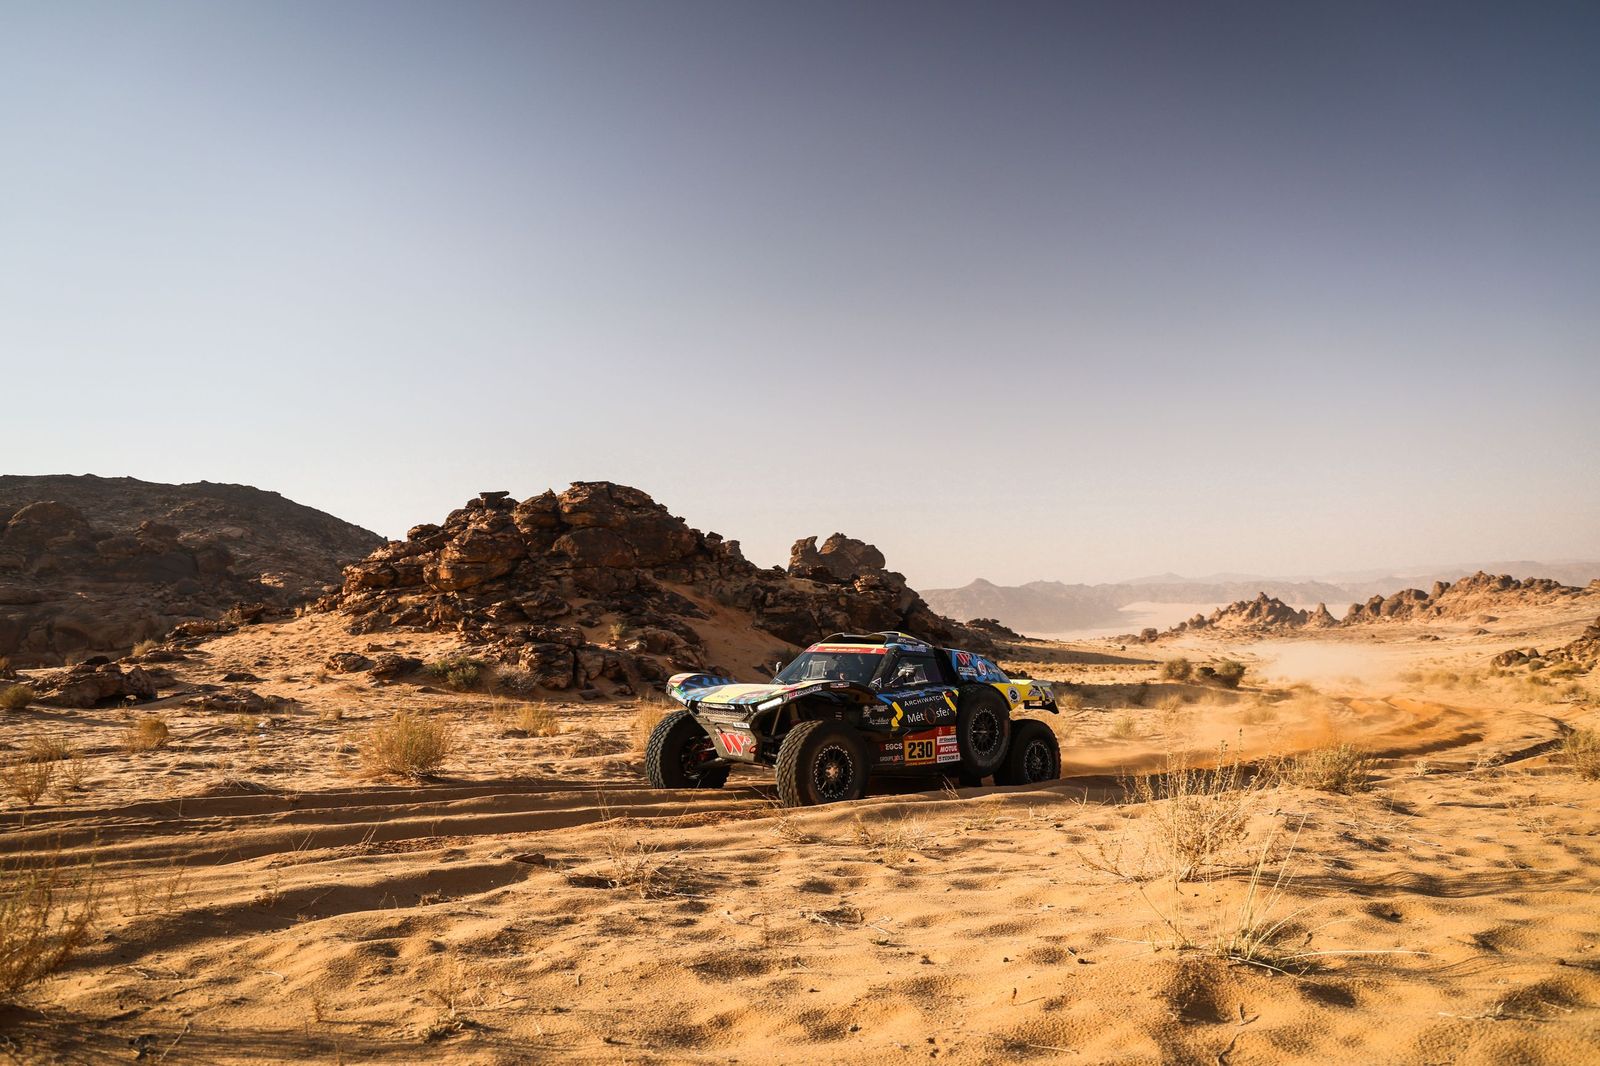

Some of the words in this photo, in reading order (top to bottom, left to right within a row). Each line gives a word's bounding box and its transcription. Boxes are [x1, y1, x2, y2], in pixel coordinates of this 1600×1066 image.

[904, 695, 945, 707] ARCHIWATCH
[908, 741, 933, 759] 230
[939, 745, 958, 753] MOTUL
